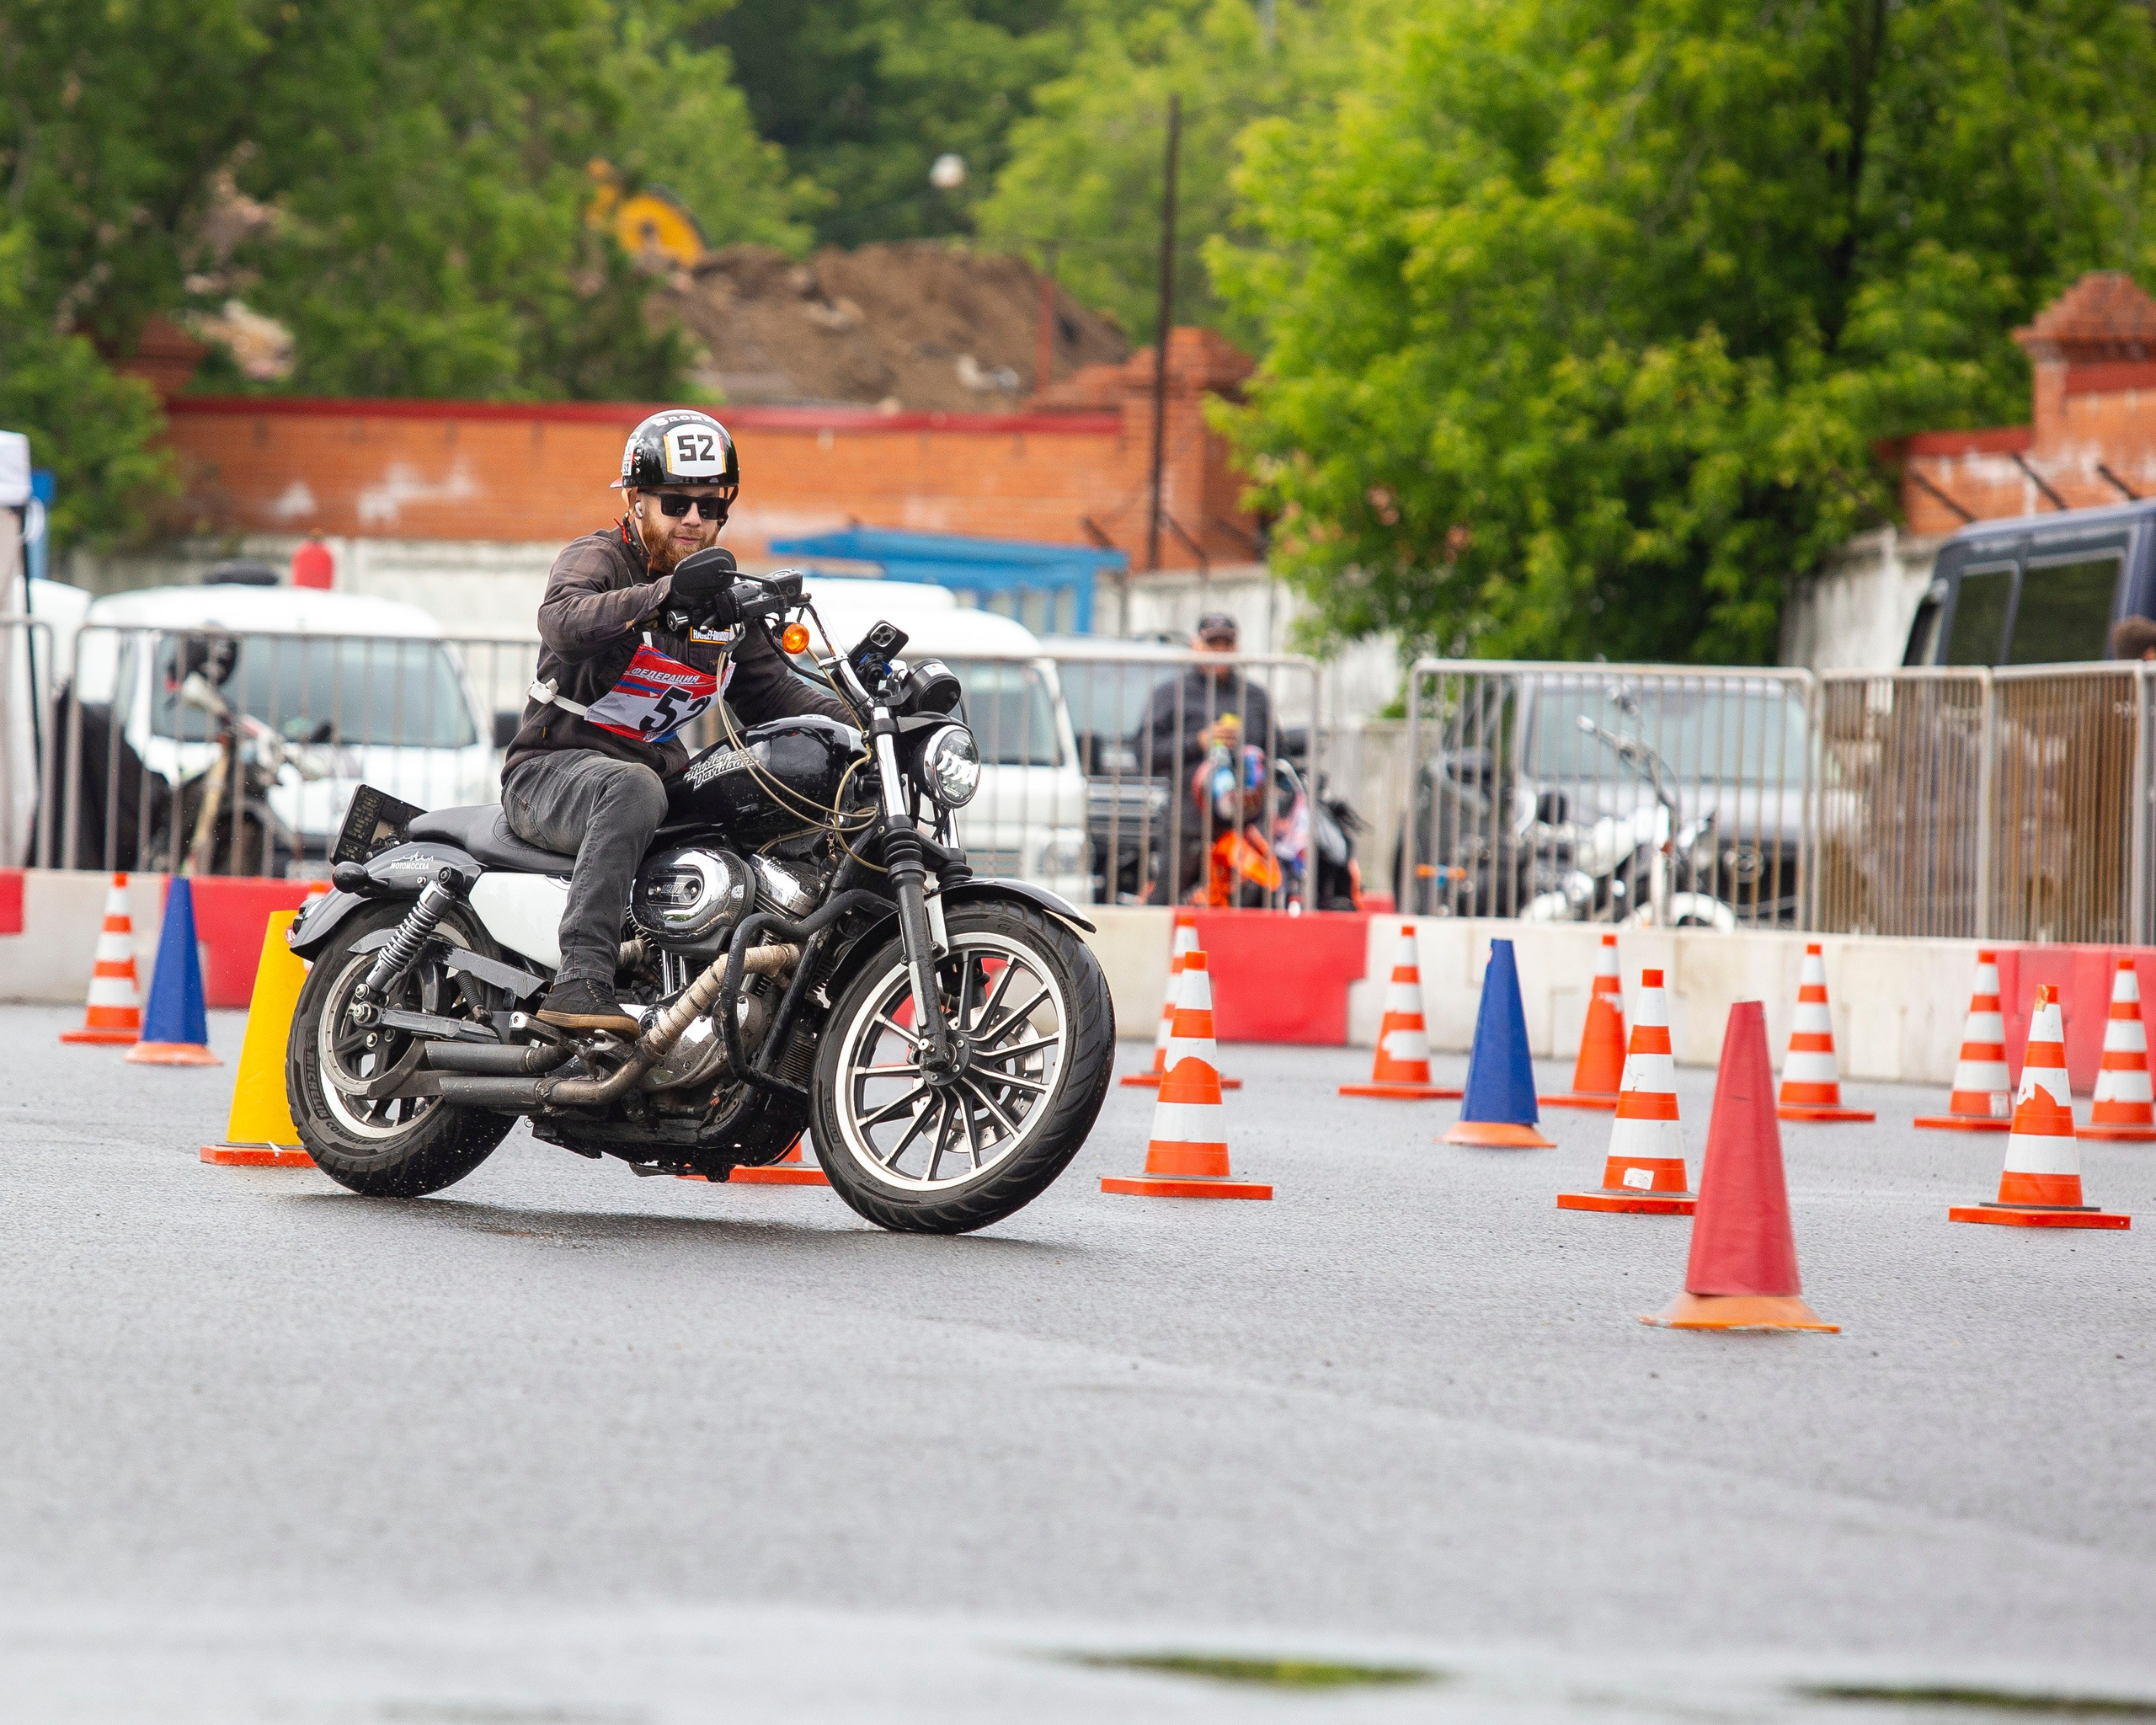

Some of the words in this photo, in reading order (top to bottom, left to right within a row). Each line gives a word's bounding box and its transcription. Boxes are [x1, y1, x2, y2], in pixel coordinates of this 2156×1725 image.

[677, 434, 716, 462] 52
[631, 667, 701, 684] ФЕДЕРАЦИЯ
[639, 686, 712, 732] 52
[683, 749, 741, 782] Harley
[660, 884, 685, 895] 1200
[305, 1049, 332, 1119] MICHELIN
